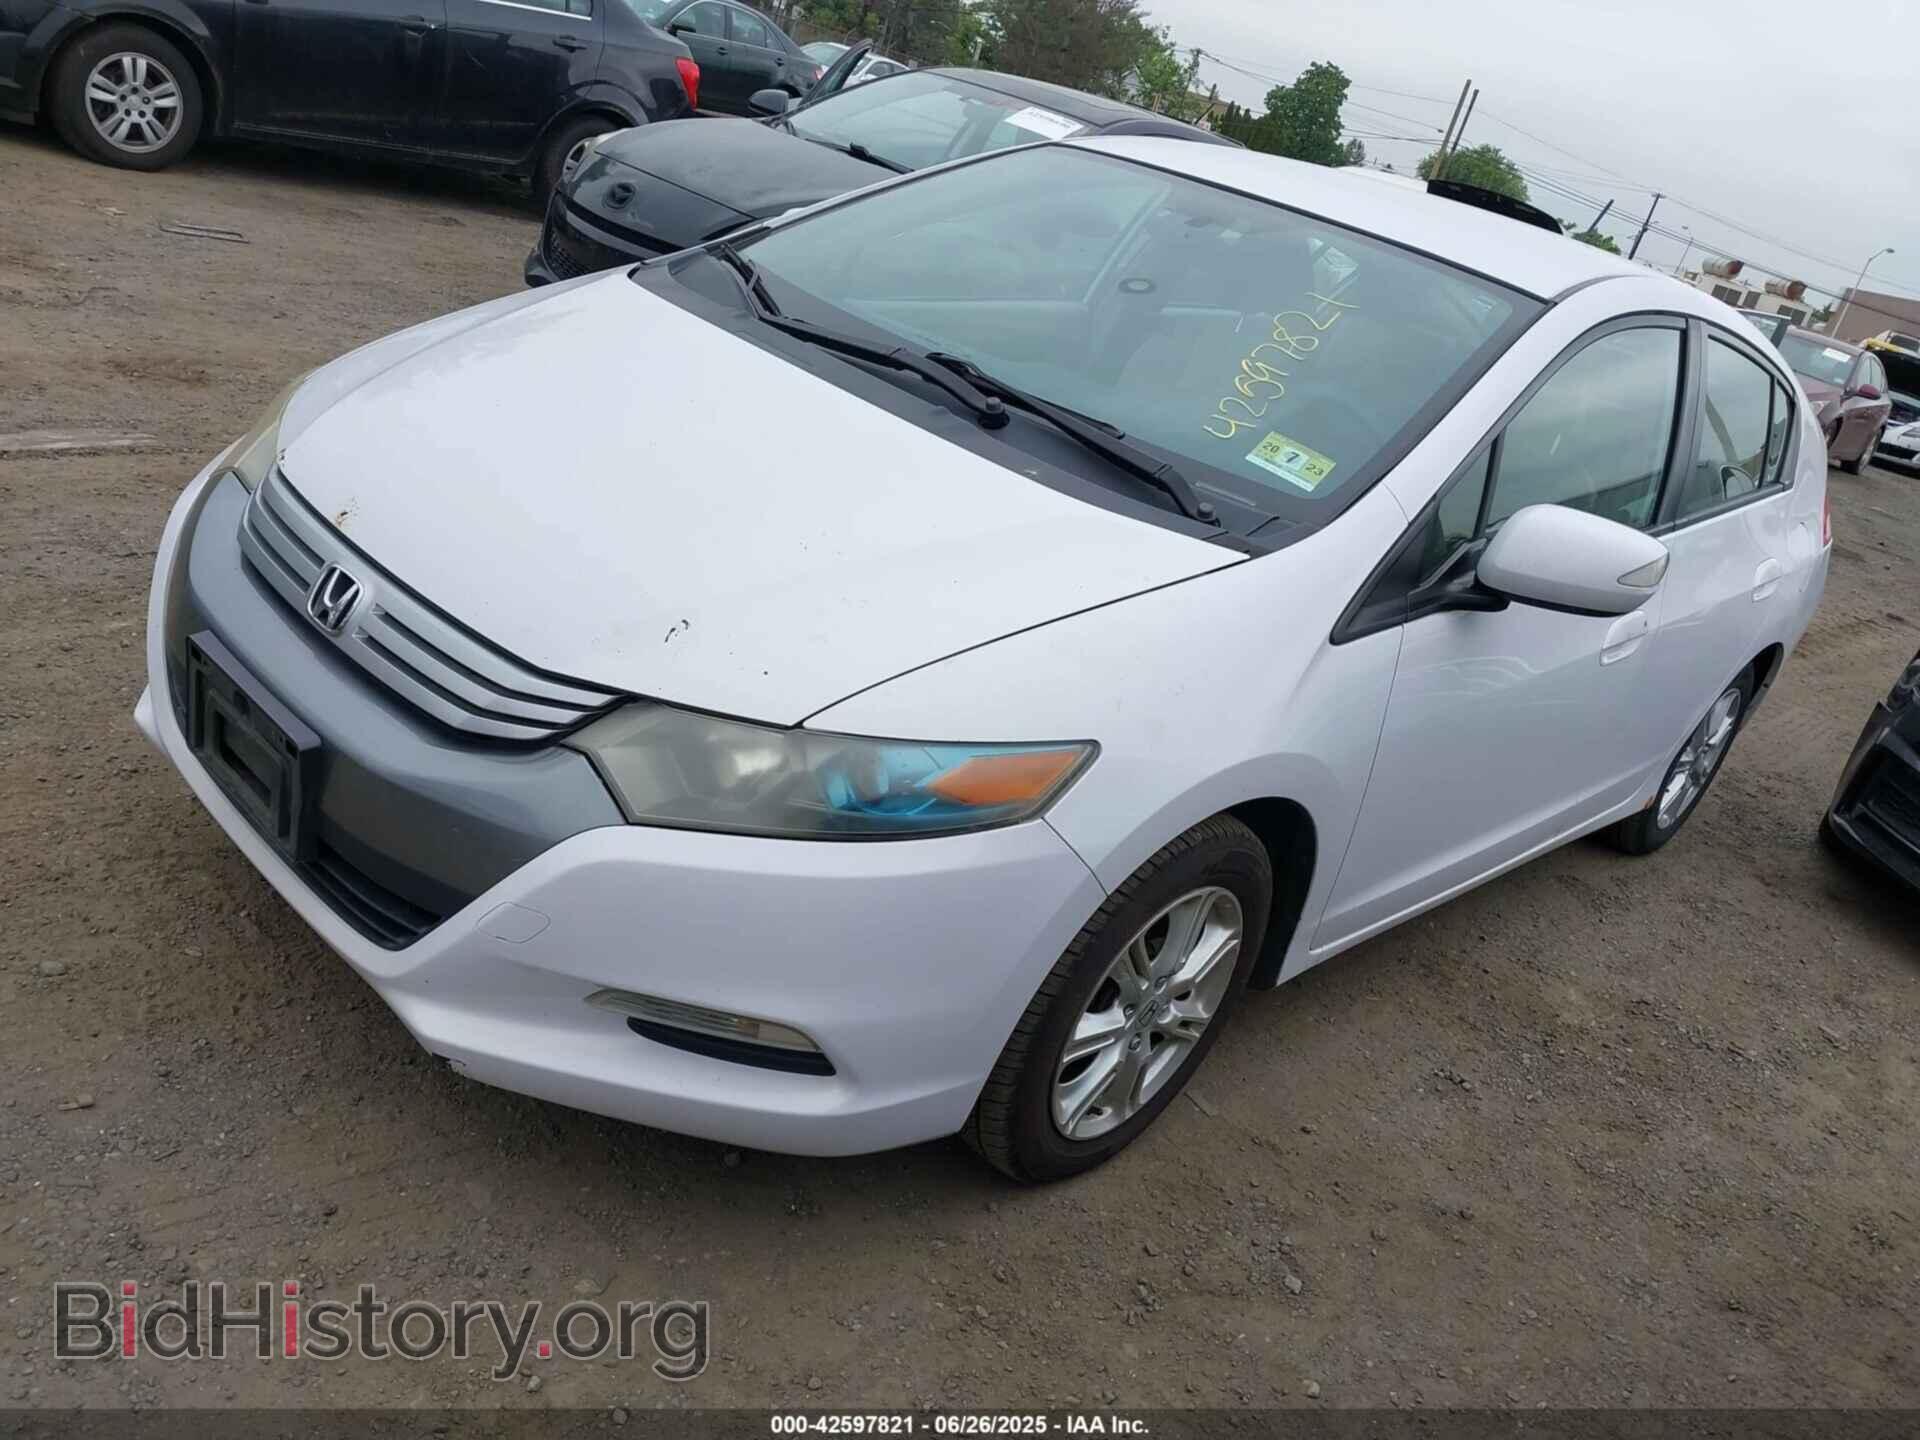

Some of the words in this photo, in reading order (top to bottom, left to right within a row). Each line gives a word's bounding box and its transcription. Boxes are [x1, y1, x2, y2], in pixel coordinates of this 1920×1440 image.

[1263, 441, 1281, 454] 20
[1285, 451, 1300, 464] 7
[1305, 463, 1325, 476] 23
